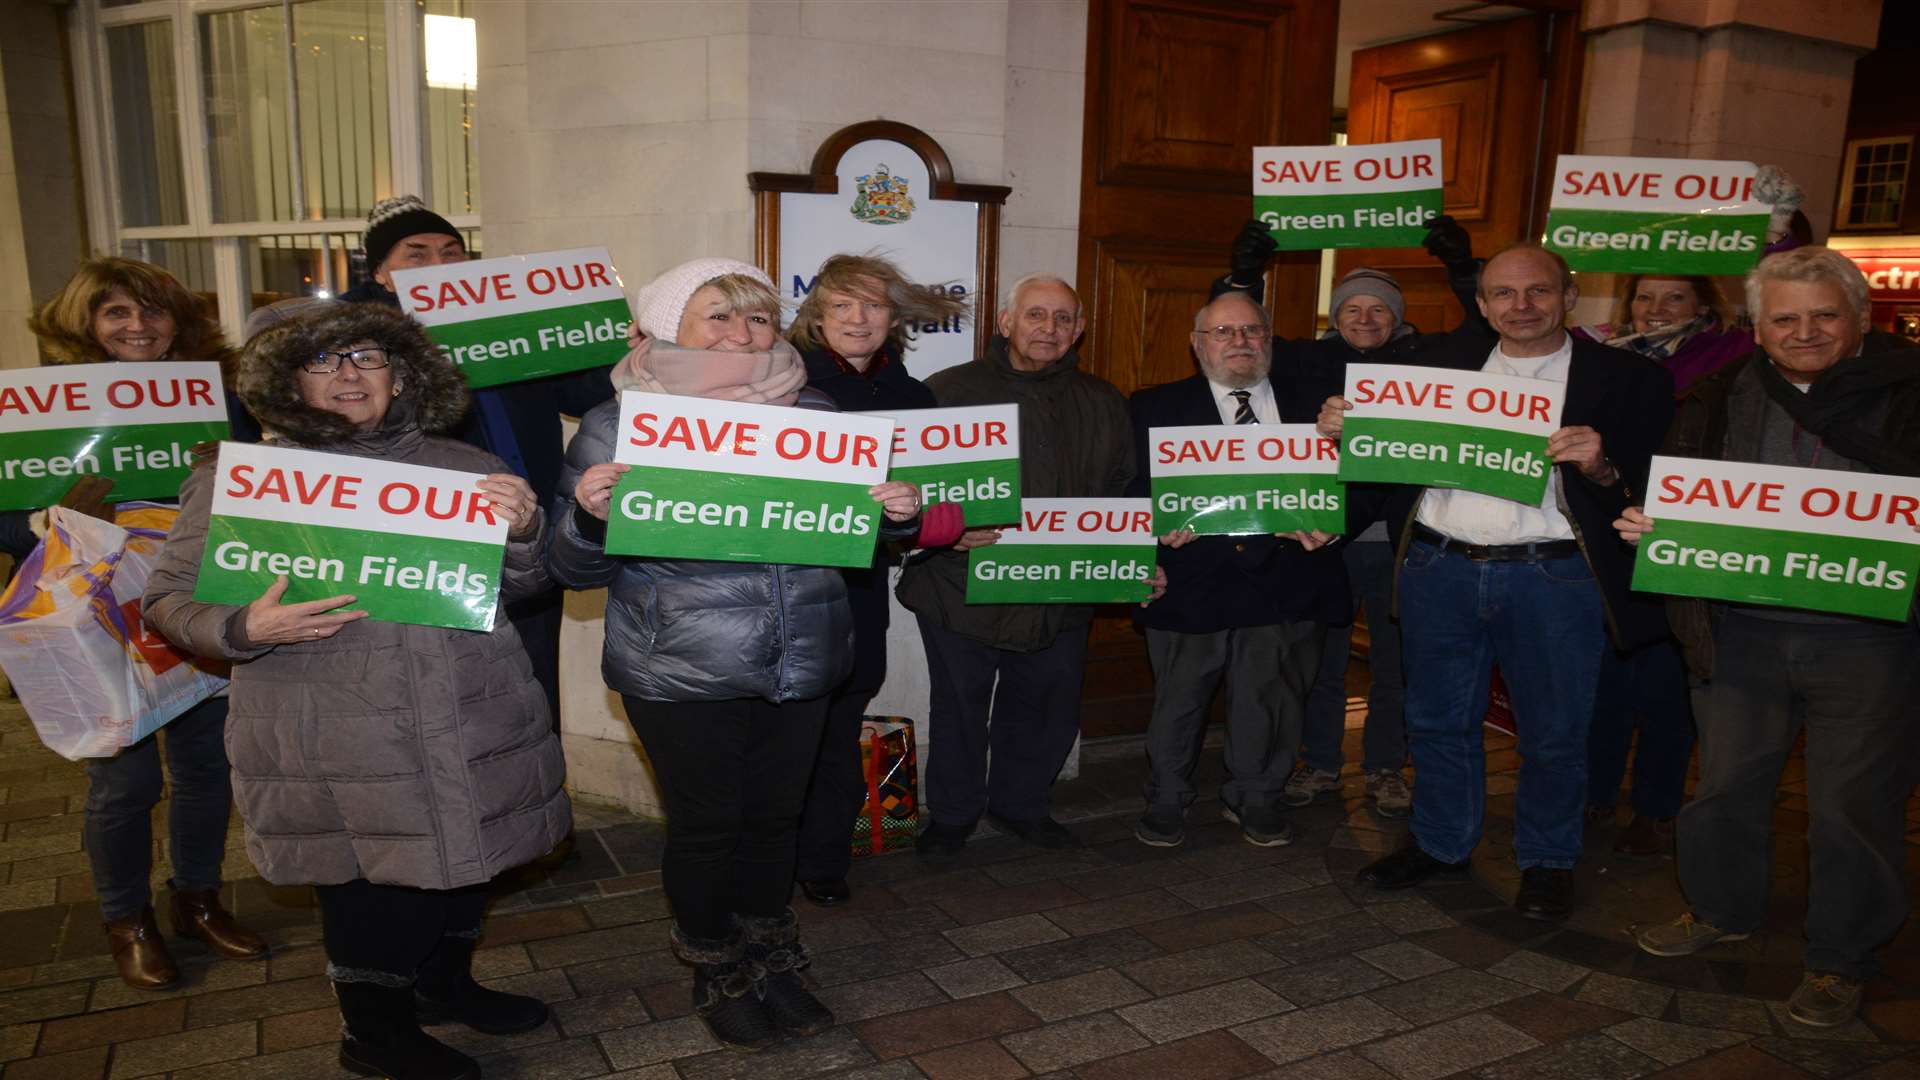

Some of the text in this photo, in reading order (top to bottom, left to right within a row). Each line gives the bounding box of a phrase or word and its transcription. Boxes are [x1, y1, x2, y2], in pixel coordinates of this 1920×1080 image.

[1261, 154, 1434, 183] SAVE OUR
[1562, 170, 1662, 198] SAVE
[1552, 225, 1757, 252] Green Fields
[409, 262, 612, 313] SAVE OUR
[538, 318, 629, 351] Fields
[106, 379, 216, 410] OUR
[1354, 379, 1551, 423] SAVE OUR
[629, 412, 761, 457] SAVE
[775, 427, 879, 469] OUR
[920, 421, 1008, 451] OUR
[1158, 437, 1337, 464] SAVE OUR
[1349, 434, 1546, 479] Green Fields
[226, 464, 497, 526] SAVE OUR
[920, 477, 1012, 506] Fields
[1158, 489, 1340, 513] Green Fields
[1657, 475, 1920, 527] SAVE OUR
[620, 490, 871, 536] Green Fields
[1077, 511, 1152, 533] OUR
[214, 541, 488, 596] Green Fields
[974, 559, 1149, 581] Green Fields
[1647, 539, 1908, 591] Green Fields
